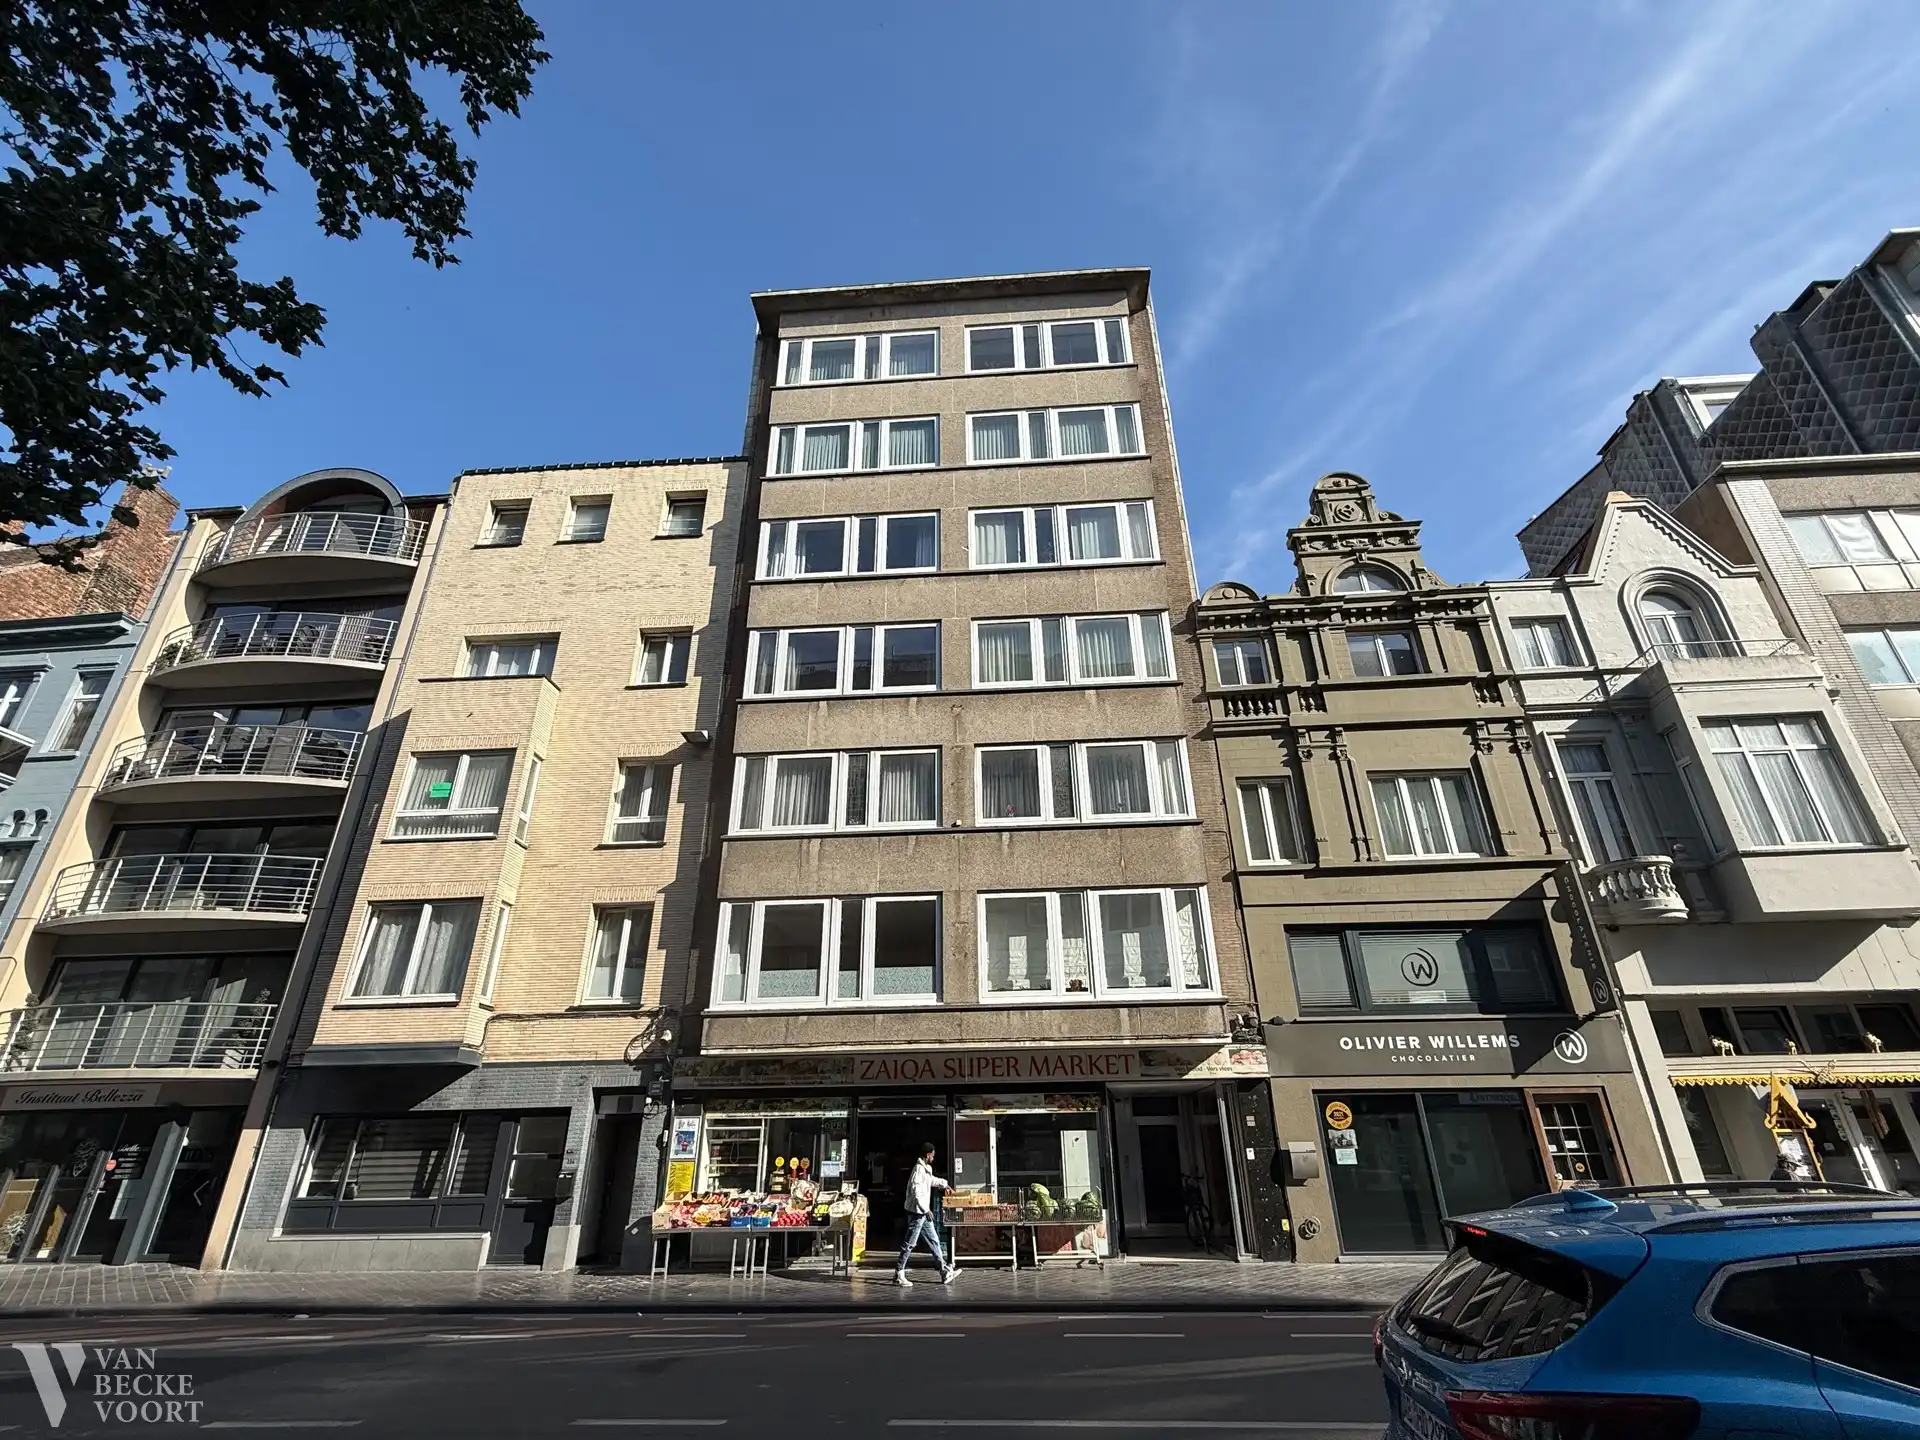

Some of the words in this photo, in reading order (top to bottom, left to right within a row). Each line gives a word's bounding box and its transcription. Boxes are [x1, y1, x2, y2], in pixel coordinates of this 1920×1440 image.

[1339, 1035, 1421, 1051] OLIVIER
[1427, 1034, 1521, 1050] WILLEMS
[1391, 1054, 1476, 1063] CHOCOLATIER
[860, 1058, 936, 1082] ZAIQA
[943, 1056, 1021, 1079] SUPER
[1028, 1053, 1135, 1077] MARKET
[81, 1087, 144, 1104] Bellezza
